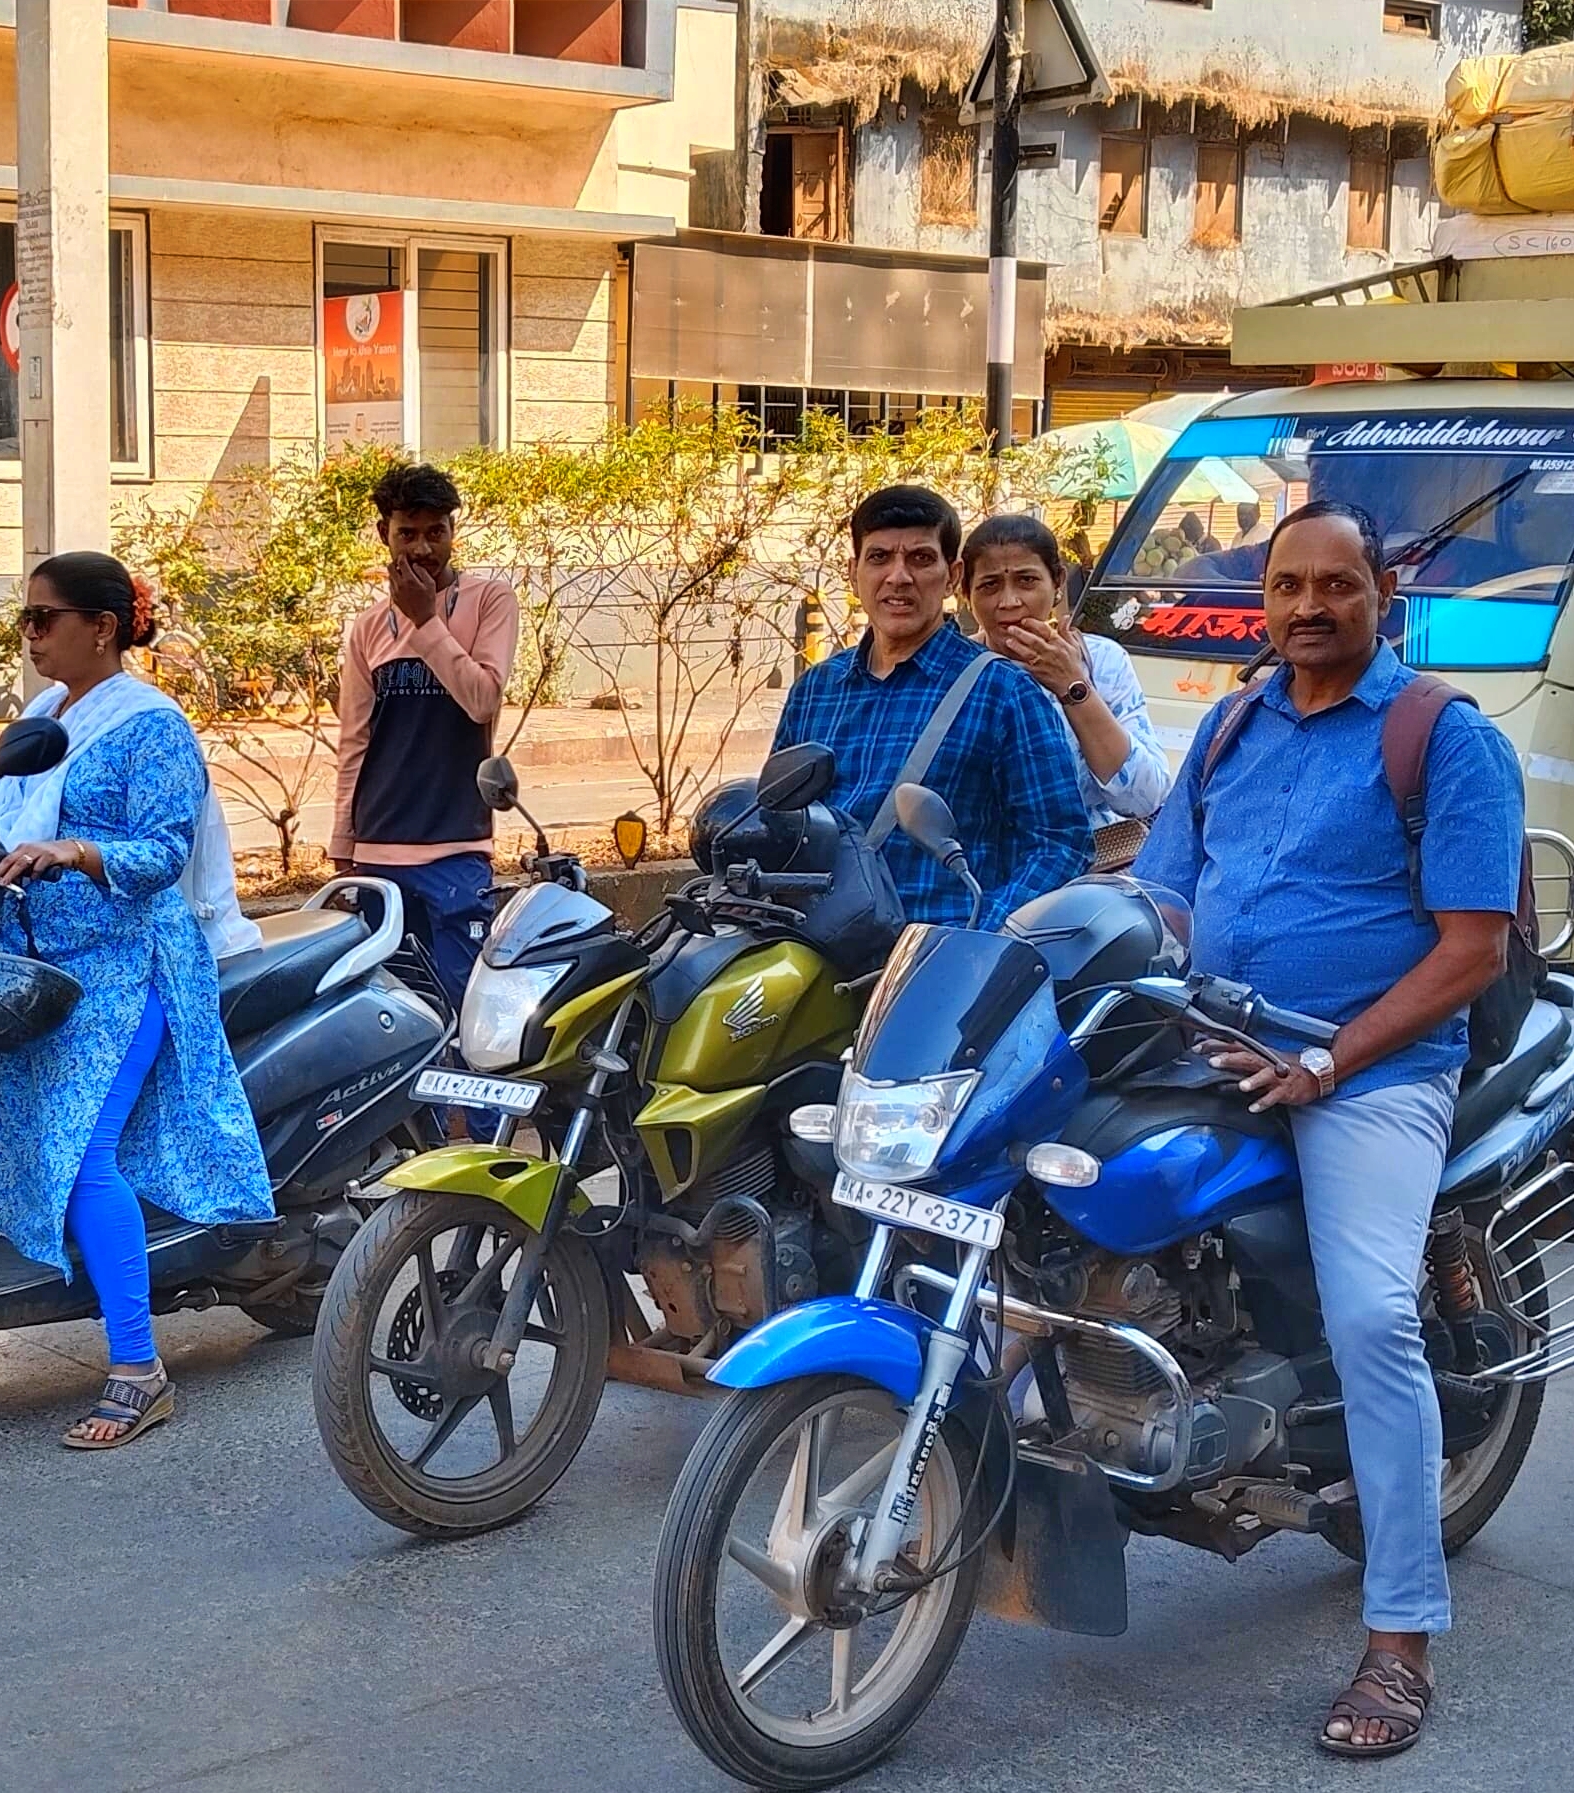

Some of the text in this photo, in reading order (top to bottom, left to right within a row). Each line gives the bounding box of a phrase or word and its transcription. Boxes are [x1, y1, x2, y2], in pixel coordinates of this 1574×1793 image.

[1326, 418, 1566, 447] Advisiddeshwar
[316, 1062, 404, 1111] Activa
[432, 1074, 451, 1093] KA
[846, 1178, 992, 1241] KA 22Y 2371
